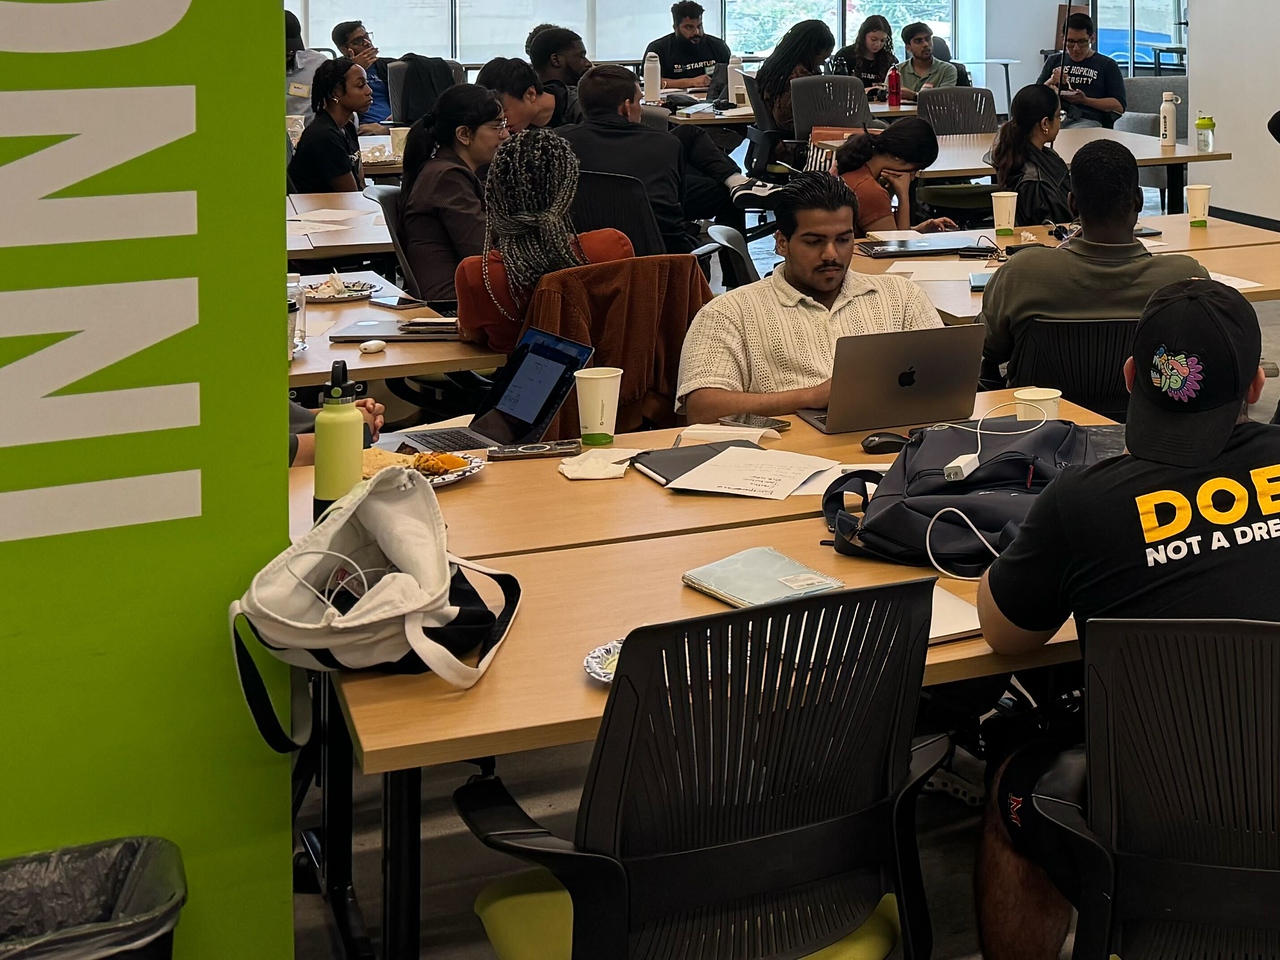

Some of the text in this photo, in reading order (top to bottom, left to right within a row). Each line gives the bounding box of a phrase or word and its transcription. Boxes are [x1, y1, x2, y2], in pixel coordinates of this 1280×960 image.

[1070, 66, 1098, 79] HOPKINS
[1067, 77, 1093, 85] ERSITY
[1145, 536, 1202, 567] NOT
[1211, 531, 1230, 551] A
